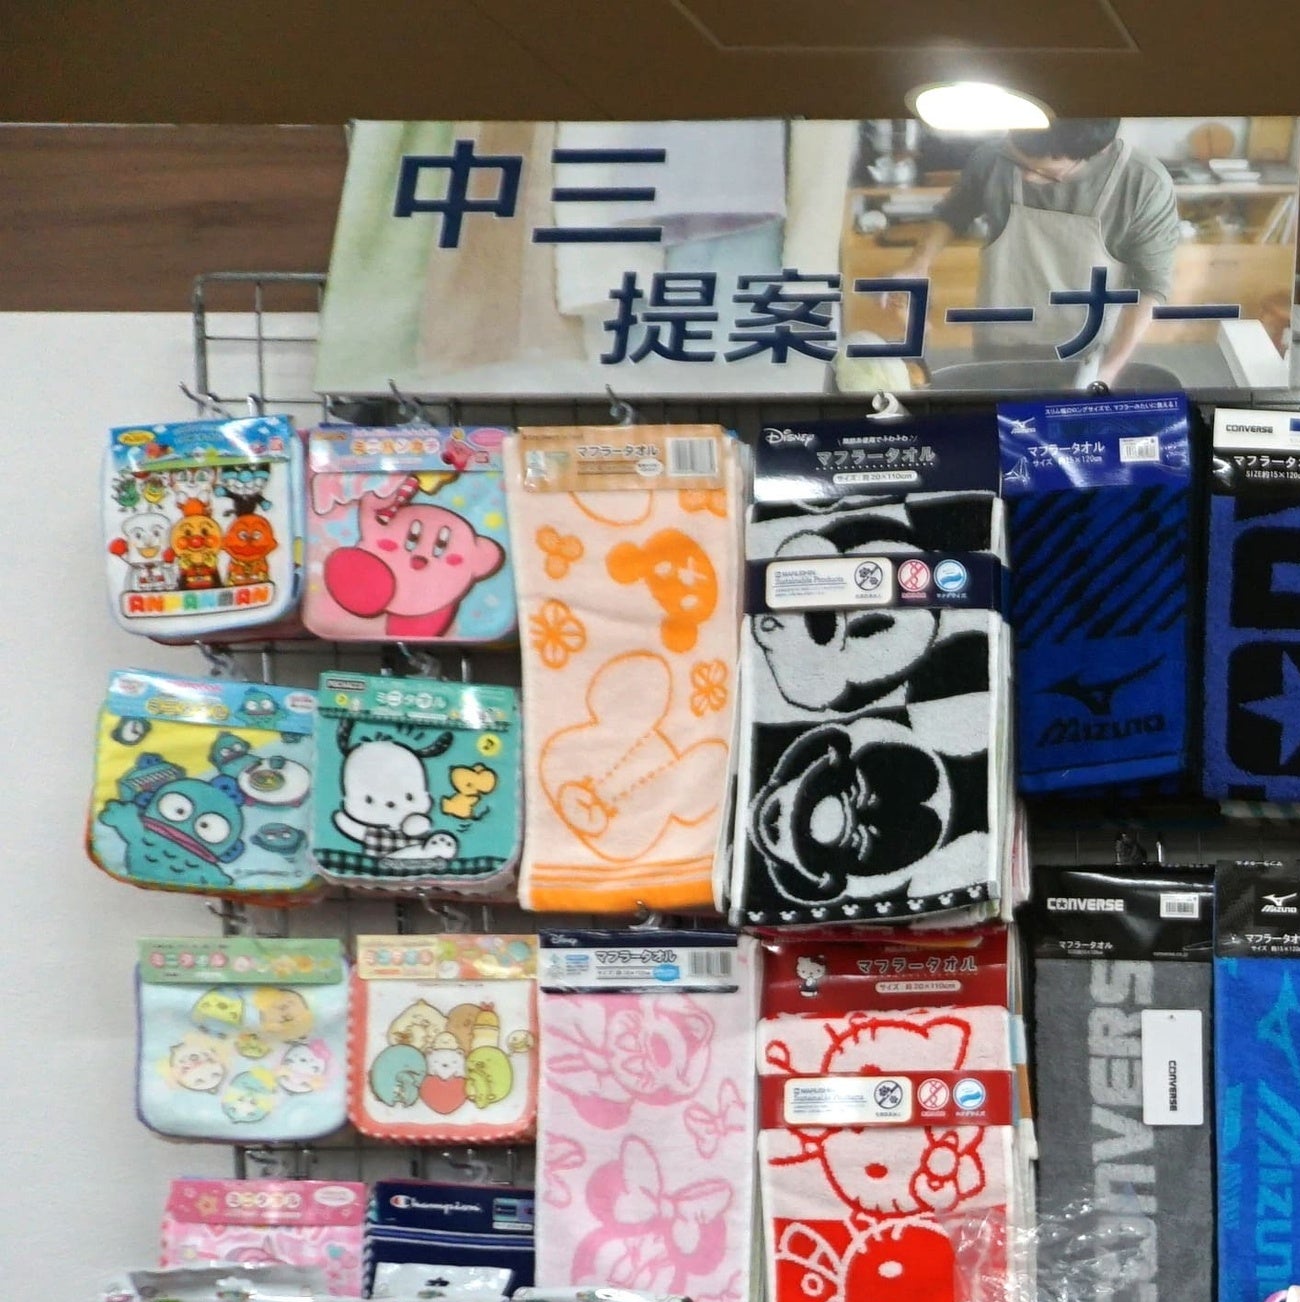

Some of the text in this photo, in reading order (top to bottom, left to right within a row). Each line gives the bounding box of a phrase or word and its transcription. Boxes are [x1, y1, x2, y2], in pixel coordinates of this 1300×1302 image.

[392, 140, 665, 249] 中三
[601, 268, 1240, 365] 提案コーナー
[1226, 425, 1273, 434] CONVERSE
[577, 444, 658, 457] マフラータオル
[816, 446, 935, 466] マフラータオル
[1027, 442, 1105, 456] マフラータオル
[1046, 898, 1123, 911] CONVERSE
[595, 950, 677, 963] マフラータオル
[857, 956, 977, 972] マフラータオル
[1168, 1060, 1178, 1112] CONVERSE
[389, 1194, 481, 1214] Champion
